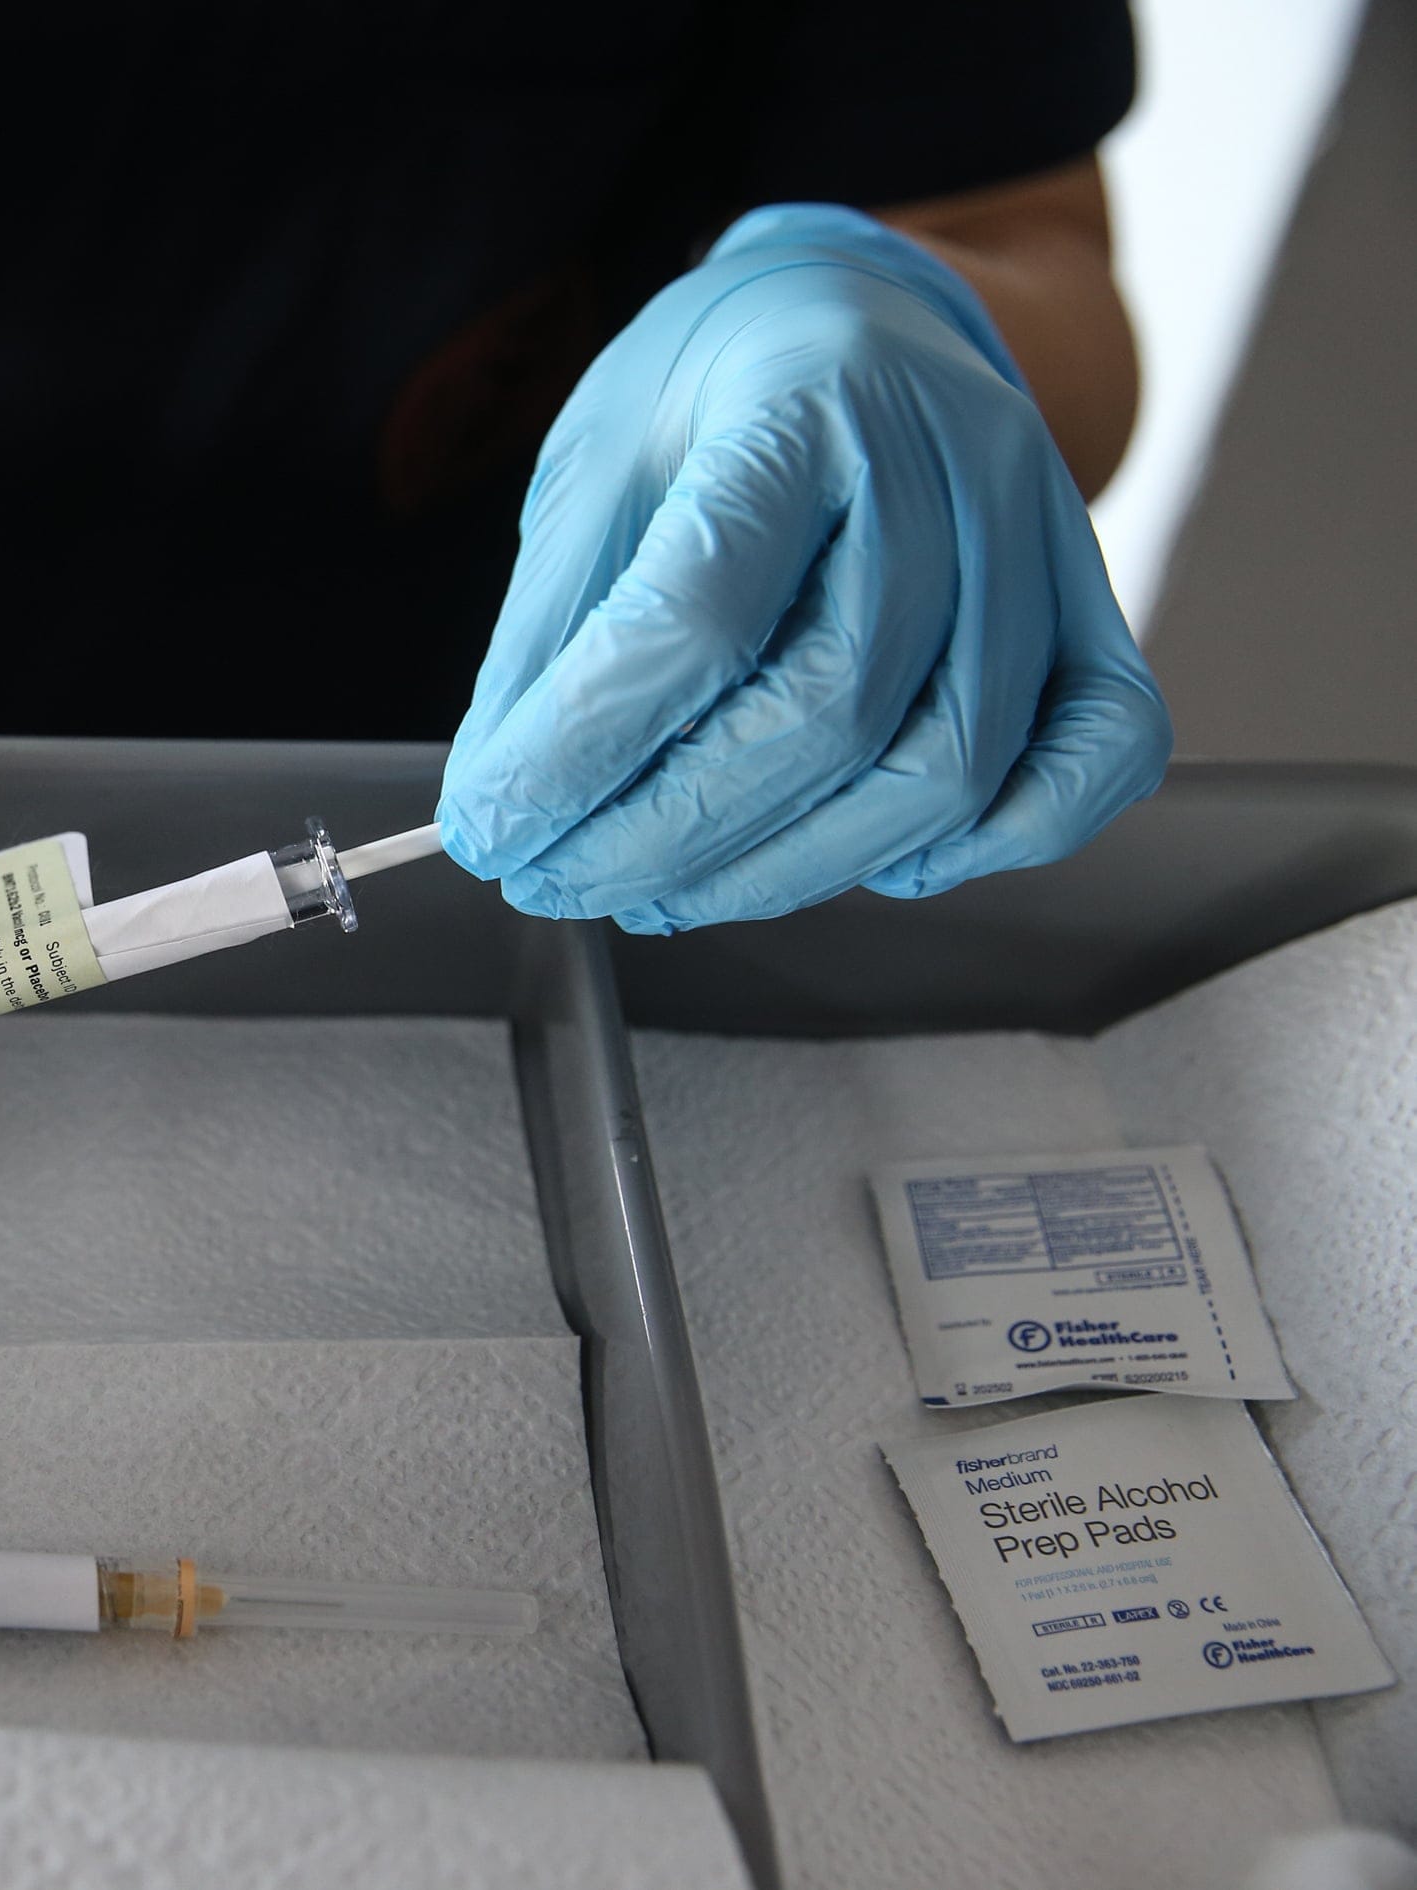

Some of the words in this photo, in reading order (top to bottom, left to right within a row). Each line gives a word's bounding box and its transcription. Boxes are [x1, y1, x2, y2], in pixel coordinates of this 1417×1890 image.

[19, 948, 32, 961] or
[46, 941, 69, 985] Subject
[0, 977, 16, 997] the
[1054, 1319, 1120, 1335] Fisher
[1059, 1330, 1179, 1348] HealthCare
[956, 1444, 1059, 1474] fisherbrand
[965, 1468, 1053, 1495] Medium
[979, 1491, 1087, 1529] Sterile
[1097, 1474, 1219, 1512] Alcohol
[993, 1530, 1079, 1563] Prep
[1084, 1515, 1177, 1547] Pads
[1015, 1578, 1033, 1589] FOR
[1033, 1568, 1094, 1585] PROFESSIONAL
[1096, 1563, 1115, 1575] AND
[1155, 1556, 1173, 1567] USE
[1117, 1609, 1155, 1623] LATEX
[1223, 1620, 1246, 1632] Made
[1256, 1616, 1282, 1628] China
[1042, 1618, 1080, 1633] STERILE
[1232, 1637, 1275, 1652] Fisher
[1237, 1645, 1315, 1663] HealthCare
[1041, 1665, 1062, 1678] Cat.
[1063, 1662, 1080, 1675] No.
[1047, 1679, 1070, 1692] NDC
